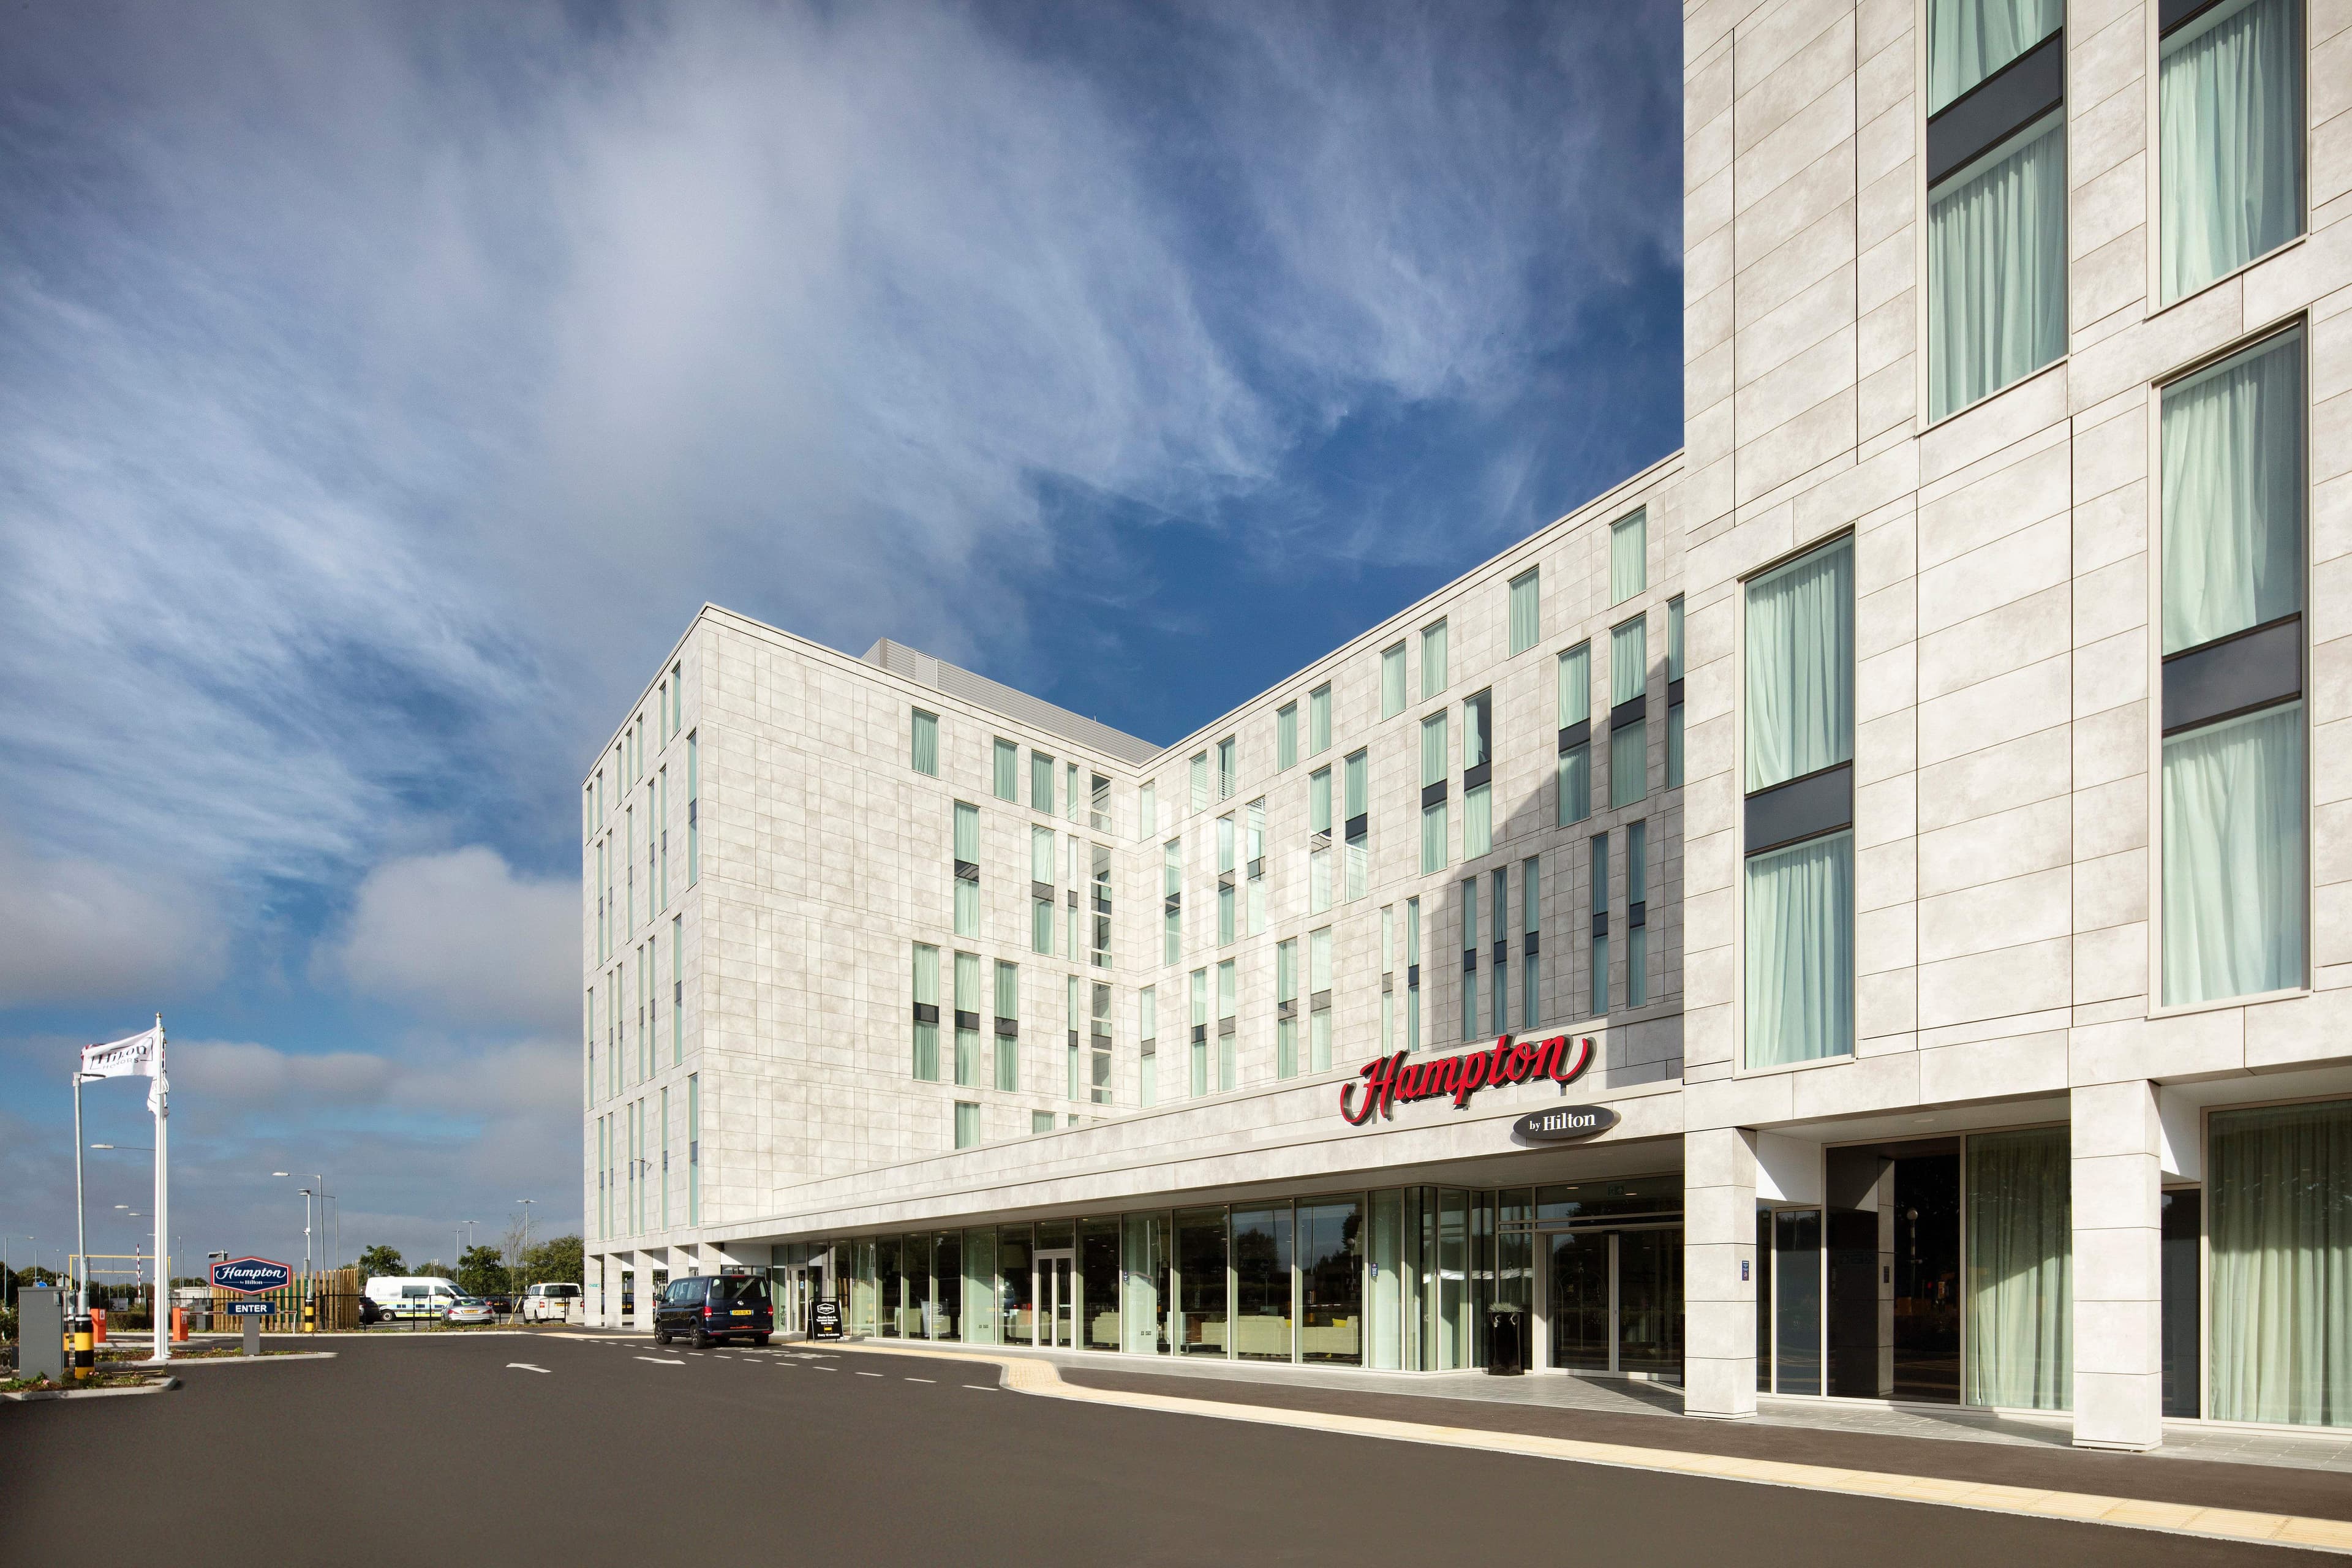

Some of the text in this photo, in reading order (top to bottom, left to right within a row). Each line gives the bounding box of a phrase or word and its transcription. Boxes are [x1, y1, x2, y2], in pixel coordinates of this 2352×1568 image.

[1340, 1035, 1591, 1124] Hampton
[1529, 1112, 1596, 1131] by Hilton
[216, 1267, 286, 1280] Hampton
